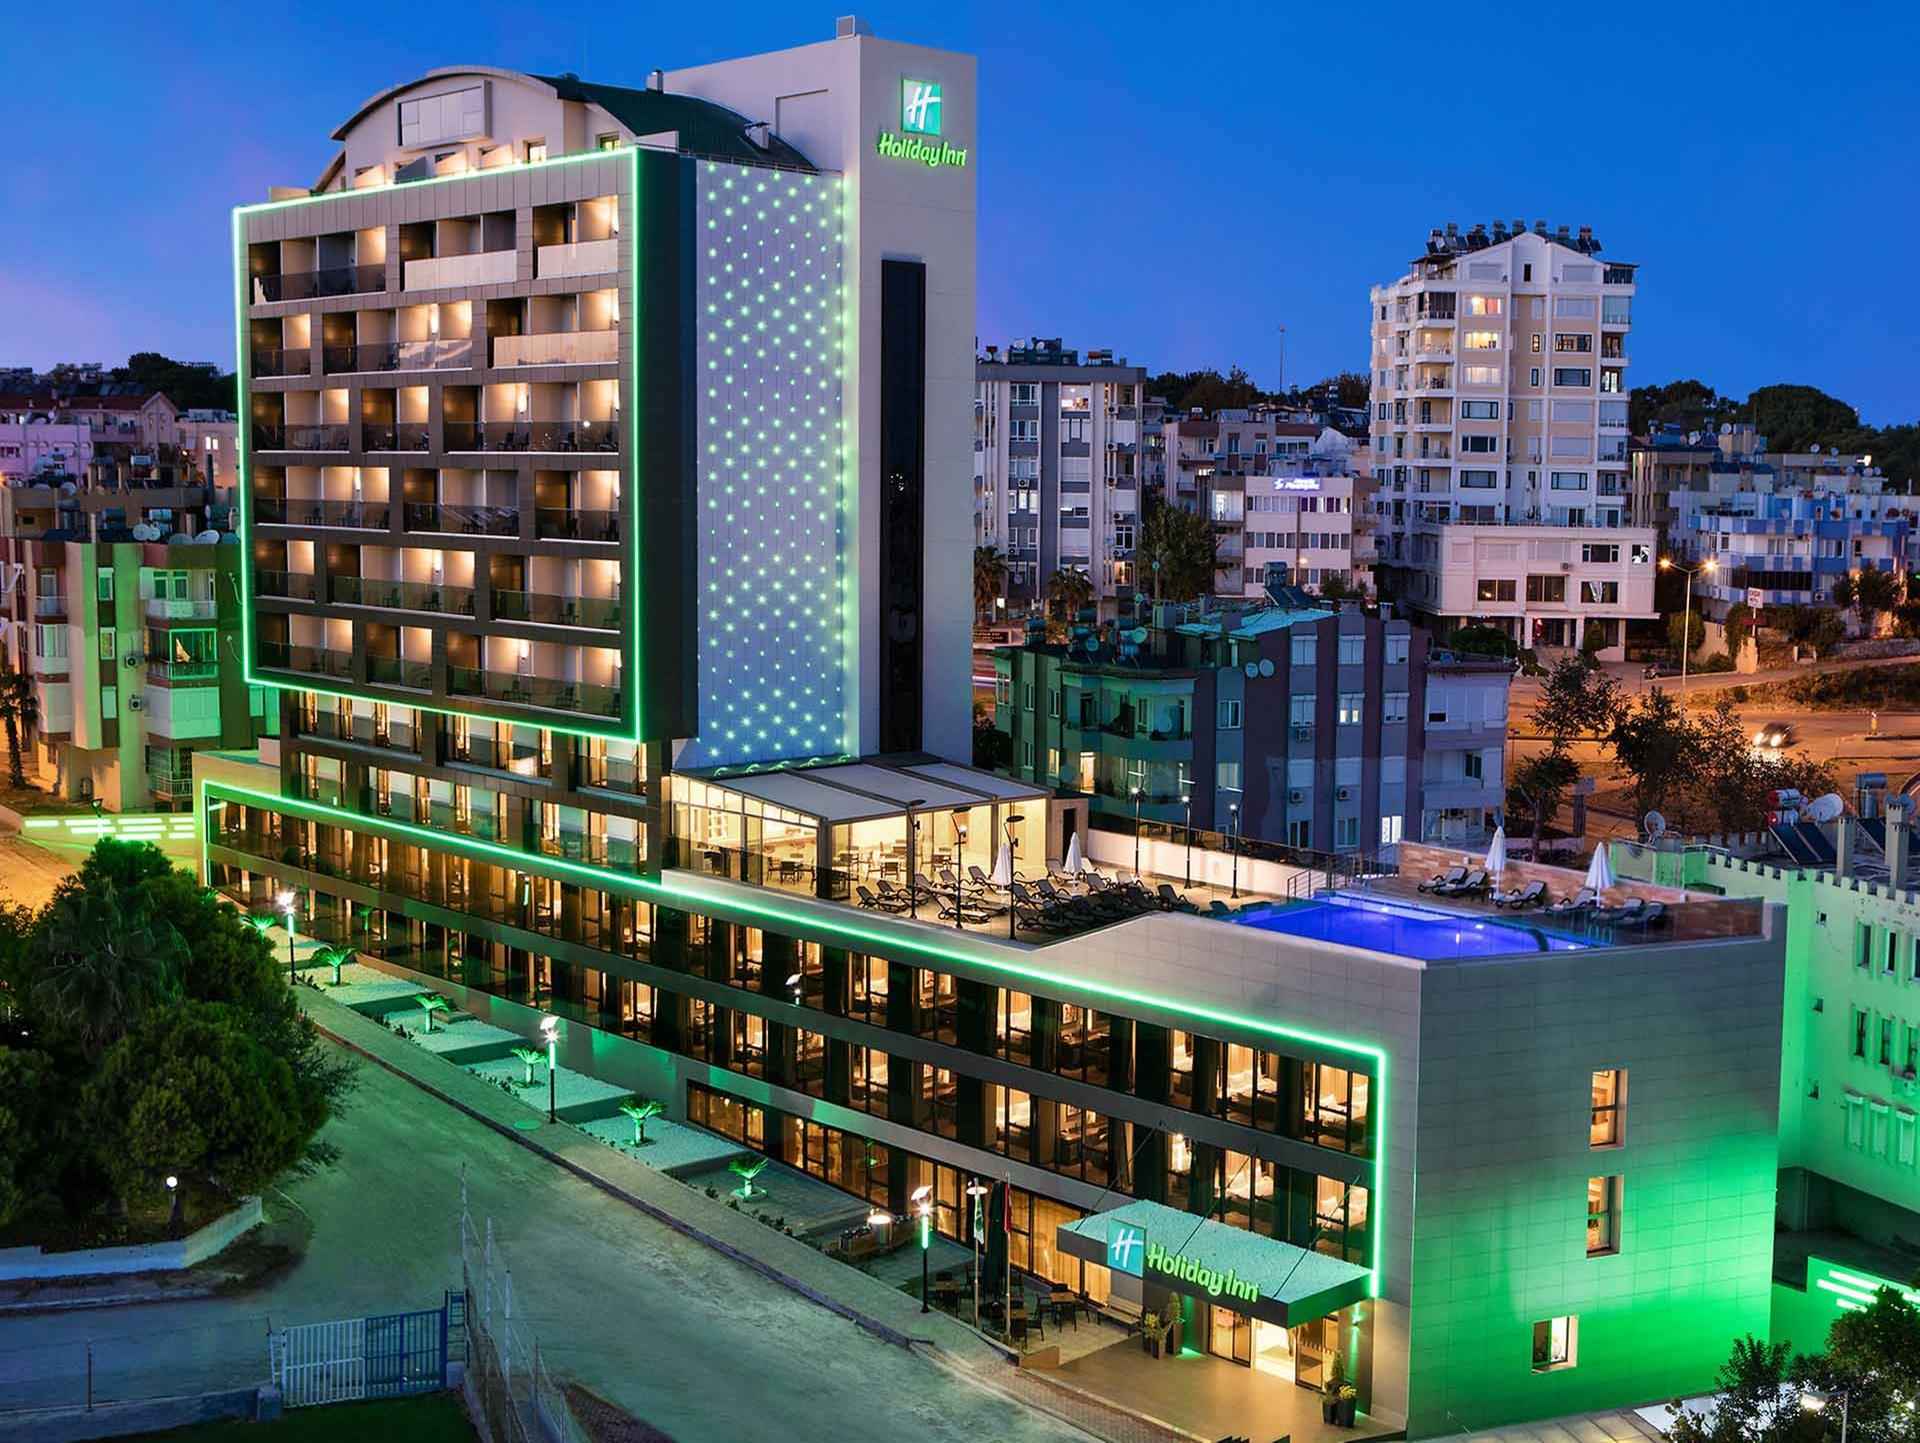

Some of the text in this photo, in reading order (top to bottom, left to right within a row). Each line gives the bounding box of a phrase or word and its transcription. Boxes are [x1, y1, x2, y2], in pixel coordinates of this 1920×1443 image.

[879, 132, 967, 167] Holiday Inn
[1147, 1242, 1259, 1303] Holiday Inn
